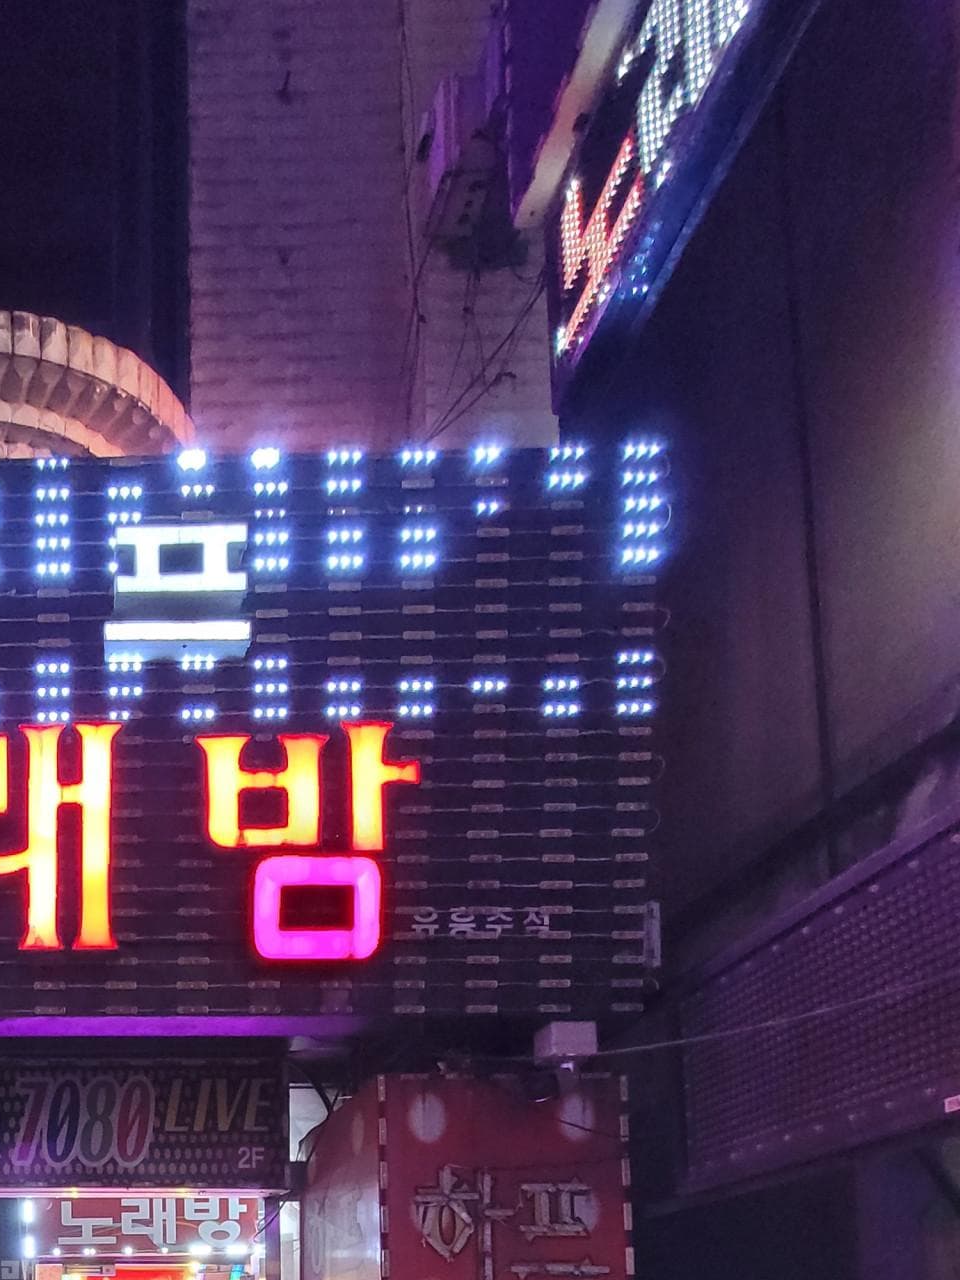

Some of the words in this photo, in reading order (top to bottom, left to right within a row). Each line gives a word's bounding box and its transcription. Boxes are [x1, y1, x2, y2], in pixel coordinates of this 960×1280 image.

[411, 905, 552, 936] 유흥주점
[11, 1075, 156, 1169] 7080
[164, 1077, 276, 1133] LIVE
[237, 1146, 266, 1169] 2F
[58, 1196, 248, 1246] 노래방
